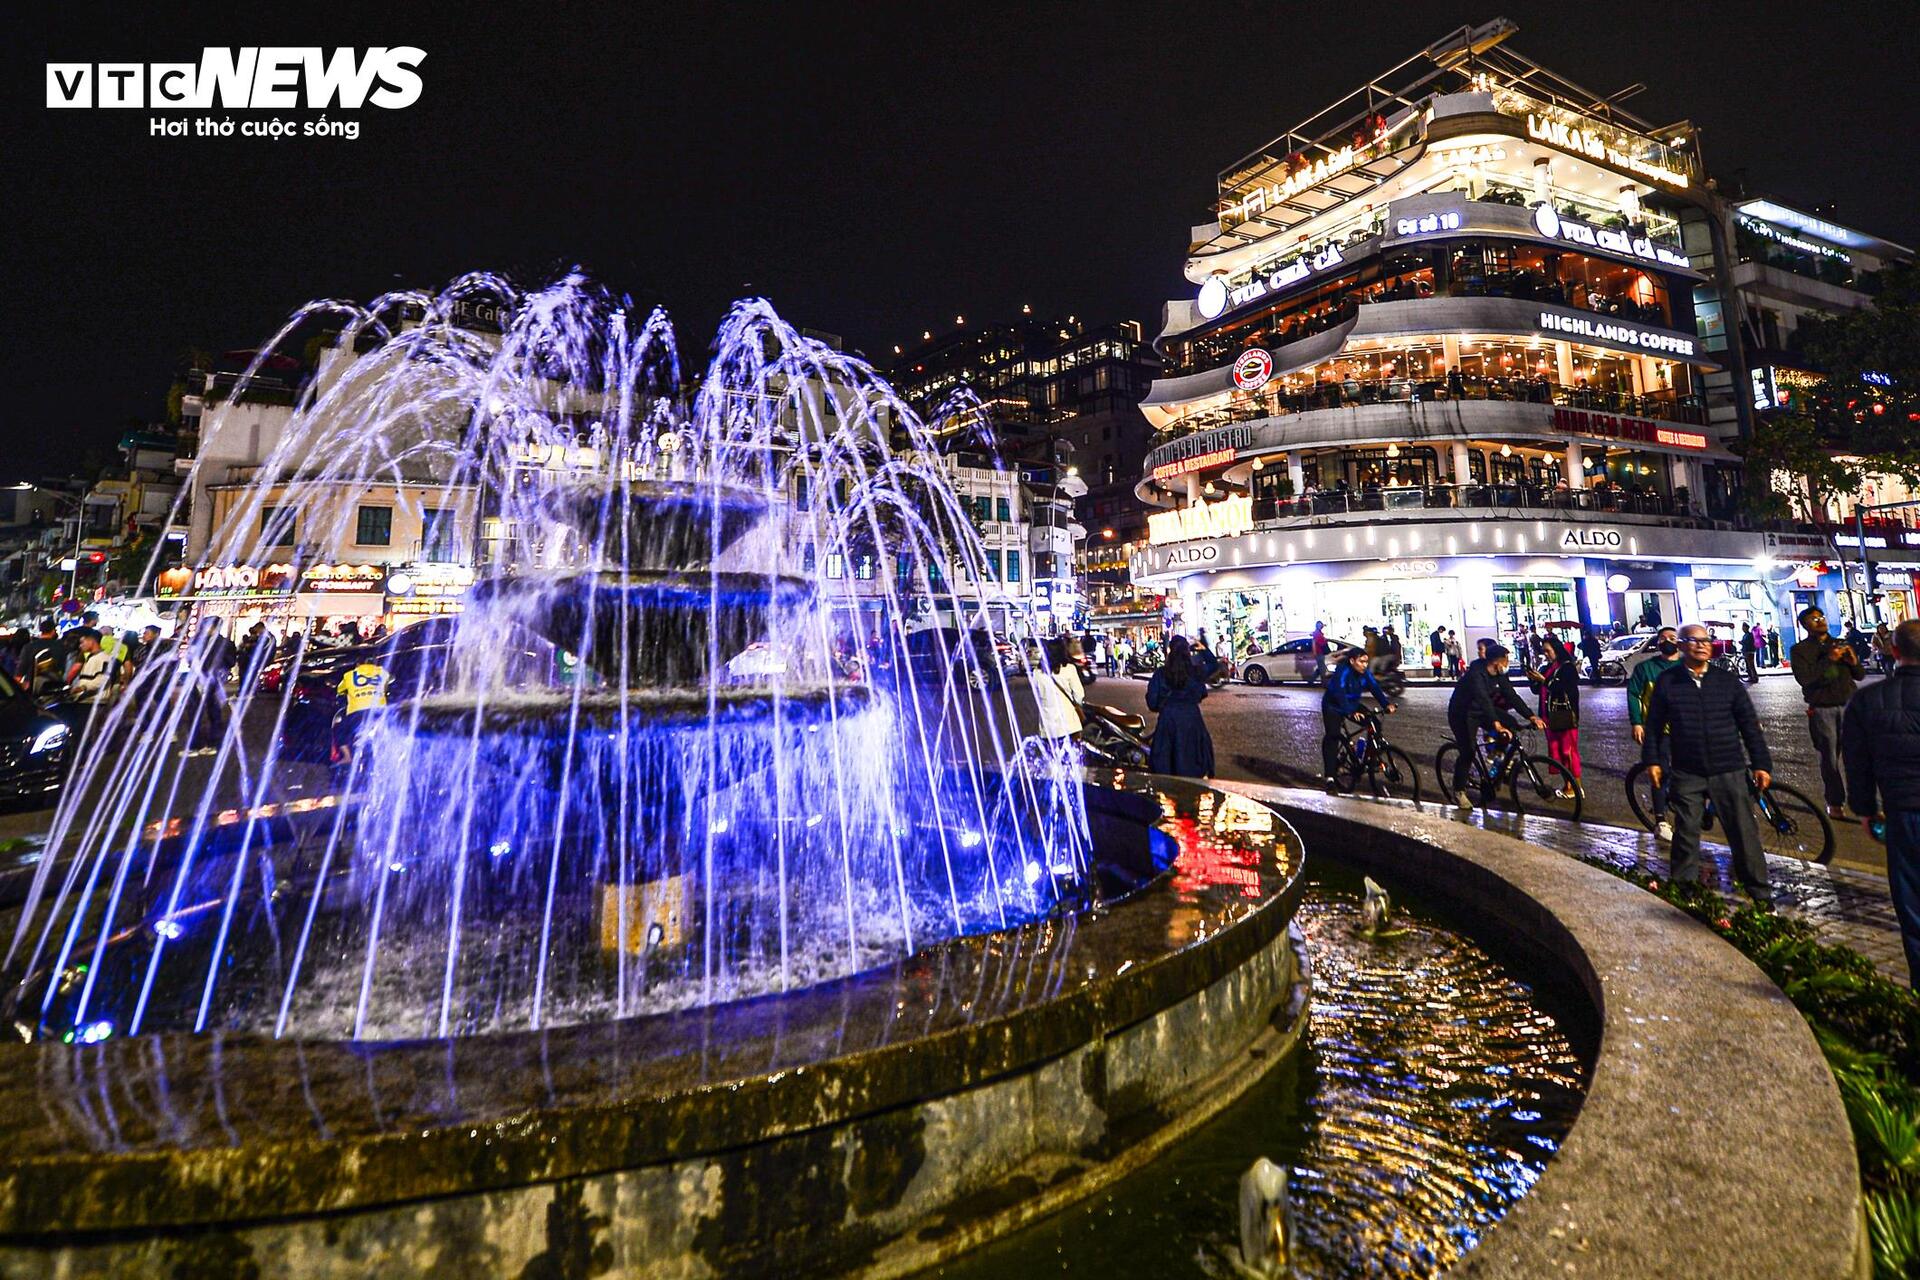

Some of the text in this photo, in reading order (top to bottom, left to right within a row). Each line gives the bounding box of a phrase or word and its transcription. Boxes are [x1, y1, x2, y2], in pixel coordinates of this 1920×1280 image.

[1440, 212, 1459, 230] 10
[1540, 312, 1694, 356] HIGHLANDS COFFEE
[1184, 448, 1235, 472] RESTAURANT
[1563, 531, 1622, 547] ALDO
[1166, 547, 1217, 566] ALDO
[352, 671, 382, 687] be
